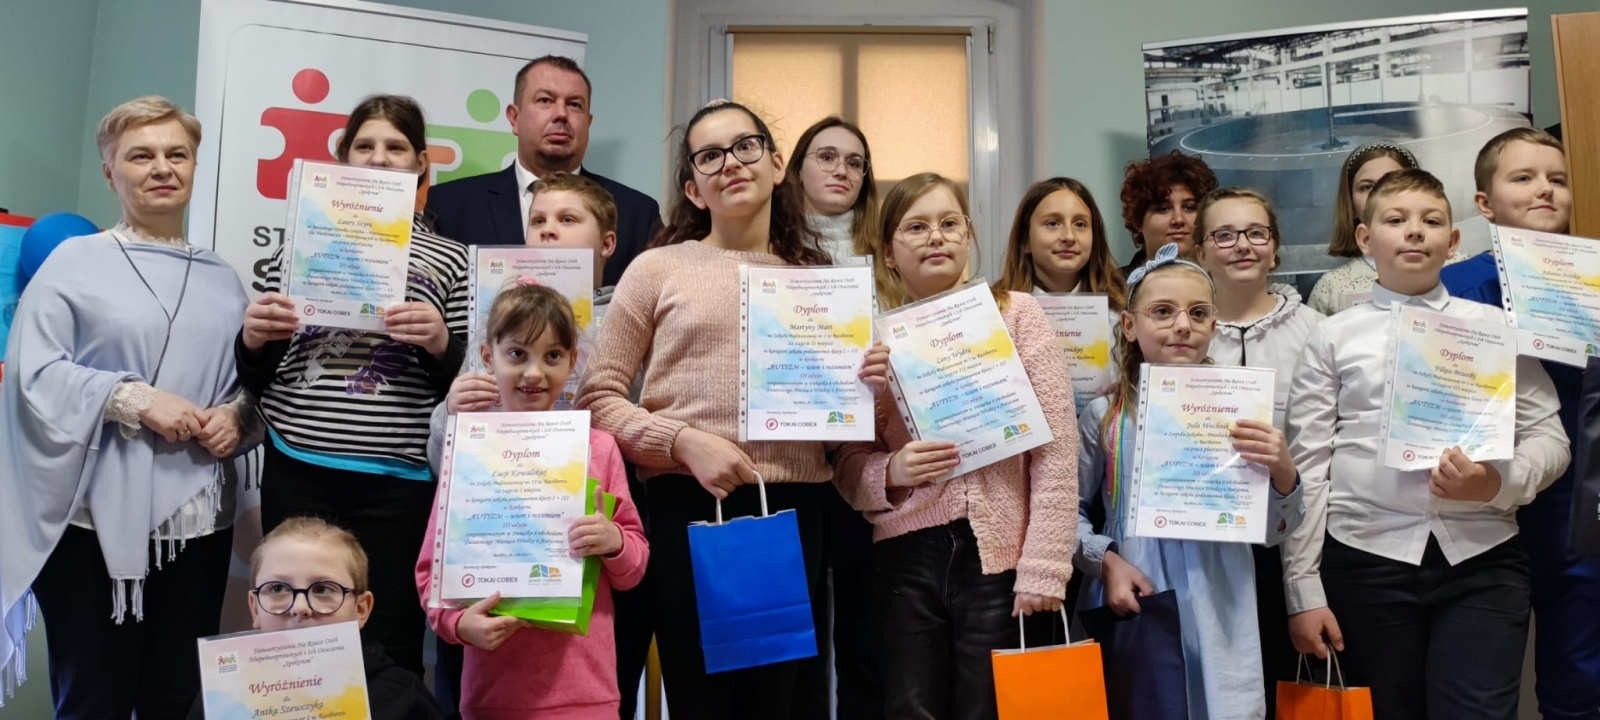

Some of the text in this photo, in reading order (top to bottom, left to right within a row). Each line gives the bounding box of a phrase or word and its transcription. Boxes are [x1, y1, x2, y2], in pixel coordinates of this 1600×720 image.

[331, 200, 384, 212] Wyróżnienie
[793, 304, 829, 316] Dyplom
[930, 332, 964, 348] Dyplom
[1440, 349, 1474, 362] Dyplom
[1181, 403, 1239, 415] Wyróżnienie
[502, 449, 540, 461] Dyplom
[961, 442, 997, 459] TOKAI COBEX
[511, 469, 548, 477] Kowalskiej
[249, 675, 323, 697] Wyróżnienie
[252, 700, 323, 718] Antka Szewczyka
